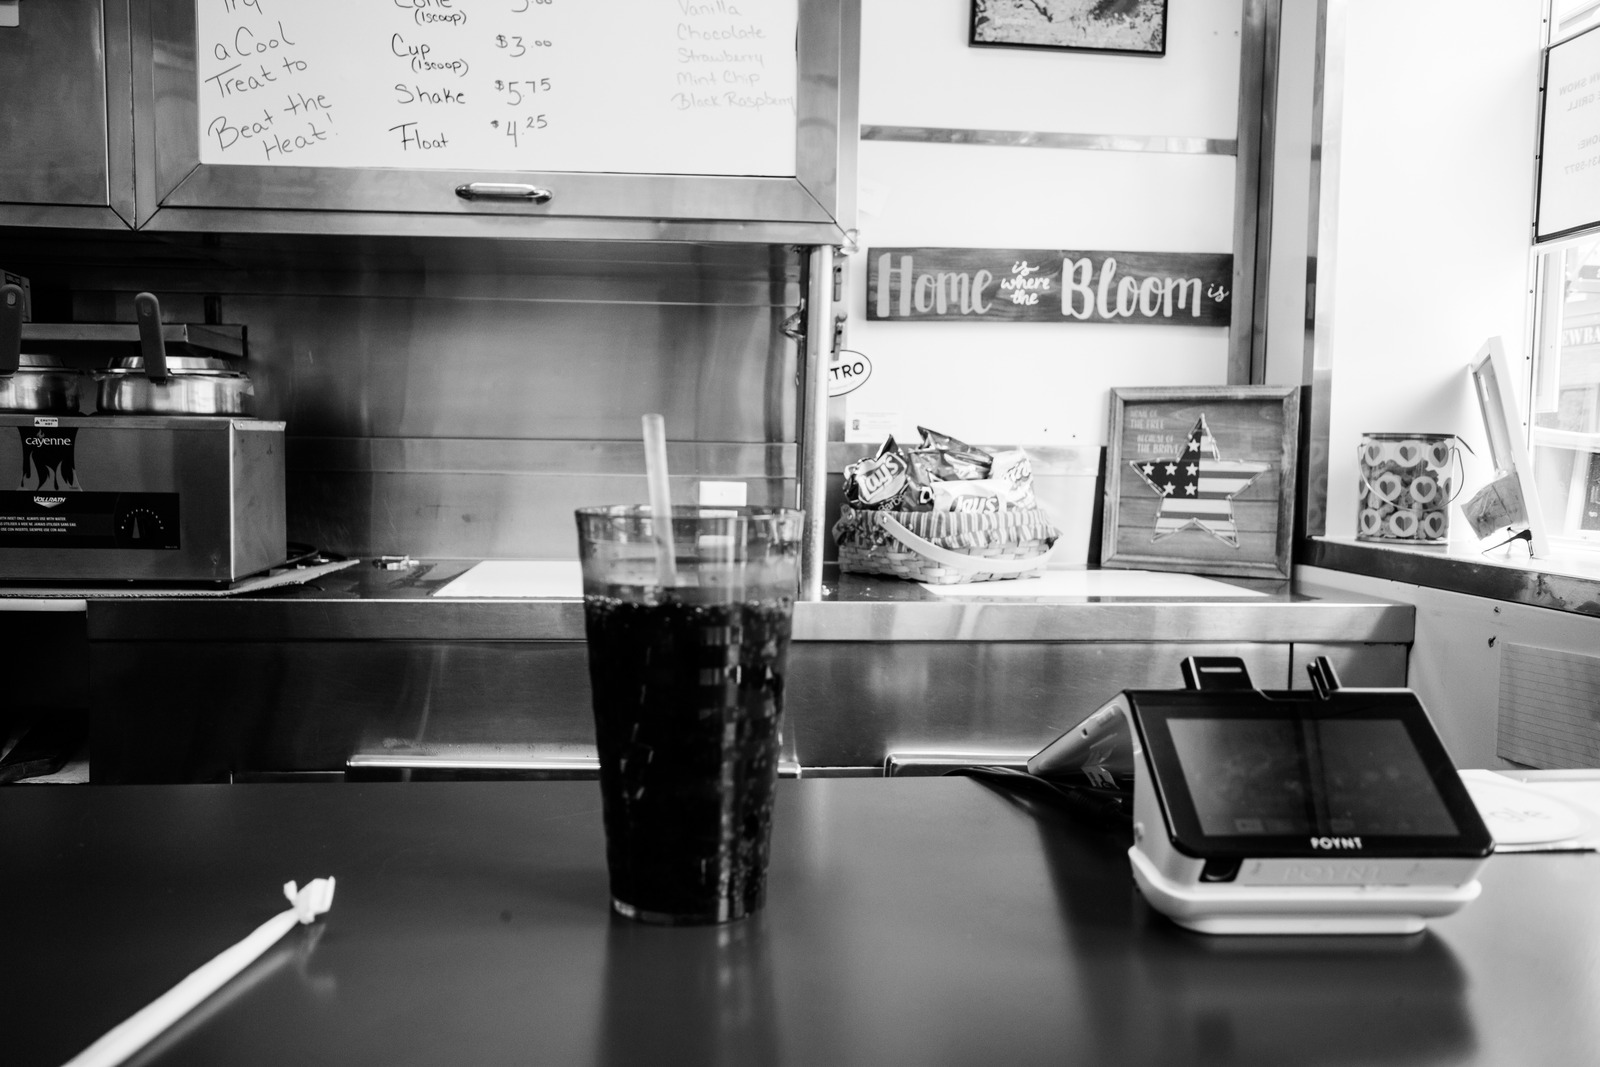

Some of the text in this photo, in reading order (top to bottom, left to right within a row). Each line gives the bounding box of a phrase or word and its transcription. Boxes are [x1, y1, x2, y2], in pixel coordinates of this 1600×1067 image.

[677, 0, 742, 17] Vanilla
[214, 21, 295, 61] a Cool
[676, 23, 767, 40] Chocolate
[391, 33, 431, 60] Cup
[495, 34, 553, 57] $3.00
[678, 47, 766, 68] Strawberry
[204, 56, 308, 98] Treat to
[676, 70, 760, 88] Mint Chip
[395, 84, 466, 105] Shake
[494, 77, 552, 106] $5.75
[670, 91, 797, 115] Black Raspberry
[207, 92, 333, 152] Beat the
[262, 112, 340, 161] Heat!
[388, 121, 450, 151] Float
[1012, 260, 1040, 275] is
[875, 251, 993, 318] Home
[1000, 275, 1051, 291] where
[1061, 256, 1203, 321] Bloom
[1207, 282, 1230, 302] is
[1010, 290, 1040, 306] the
[828, 361, 865, 381] TRO
[25, 436, 72, 448] cayenne
[1137, 443, 1150, 454] THE
[1310, 836, 1363, 850] POYNT
